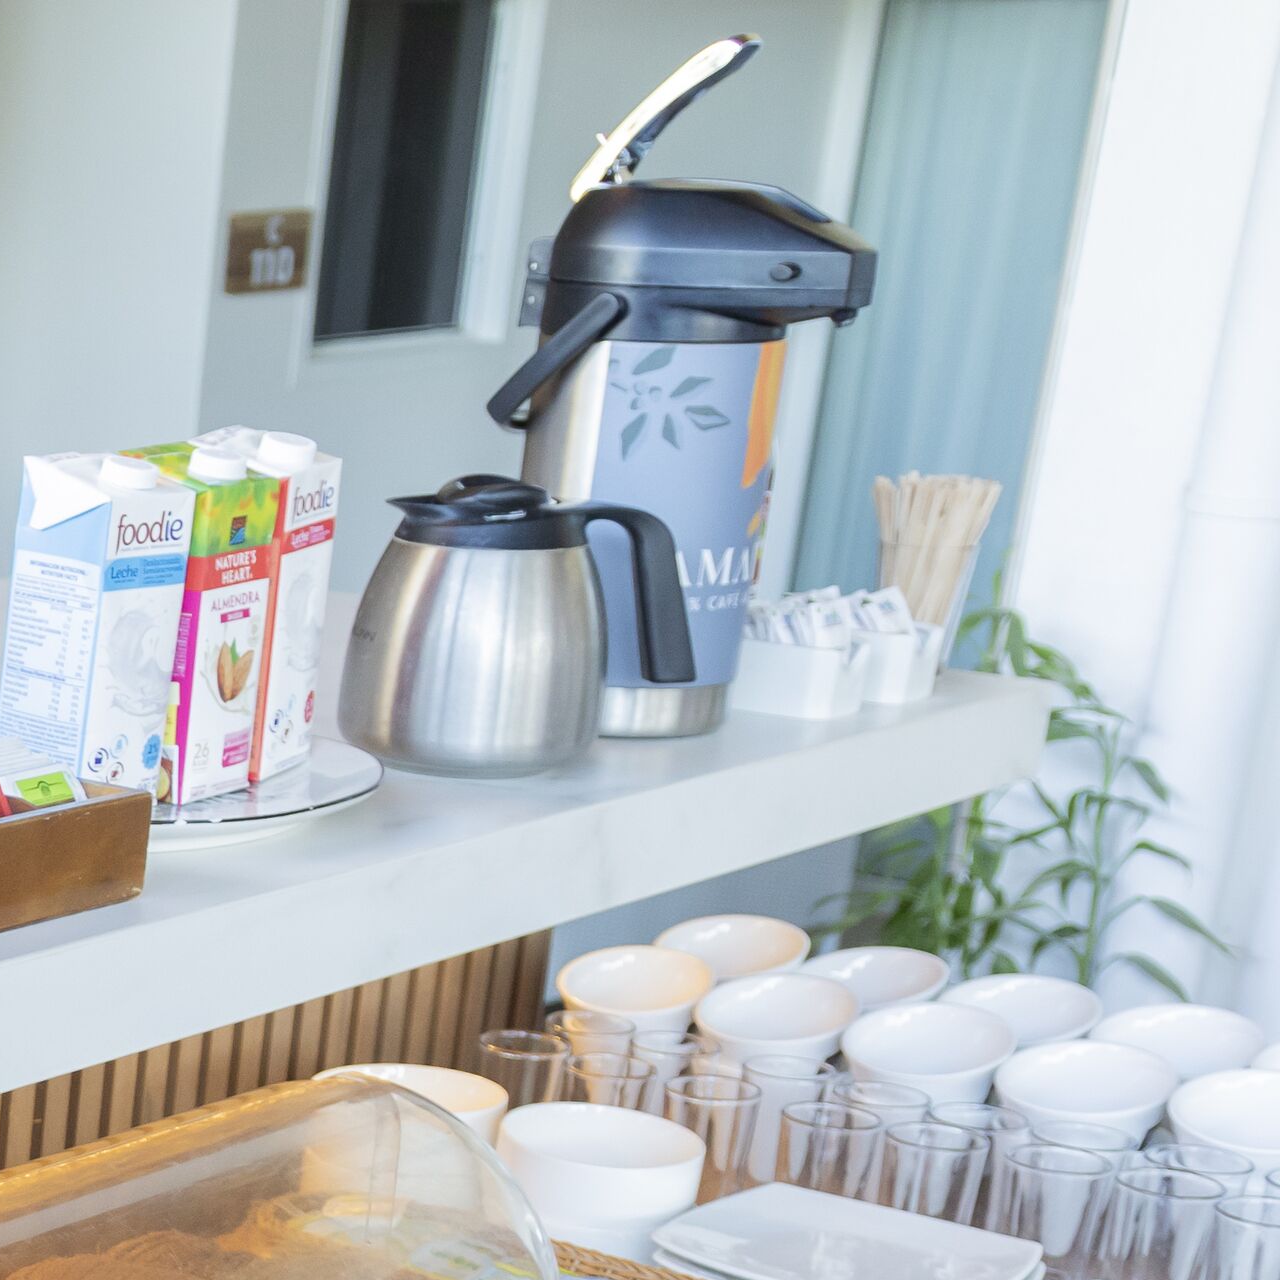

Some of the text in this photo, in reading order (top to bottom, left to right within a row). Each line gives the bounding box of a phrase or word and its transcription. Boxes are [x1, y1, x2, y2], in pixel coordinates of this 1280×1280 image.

[290, 480, 335, 527] foodie
[115, 511, 183, 555] foodie
[215, 550, 257, 571] NATURE'S
[211, 592, 260, 612] ALMENDRA
